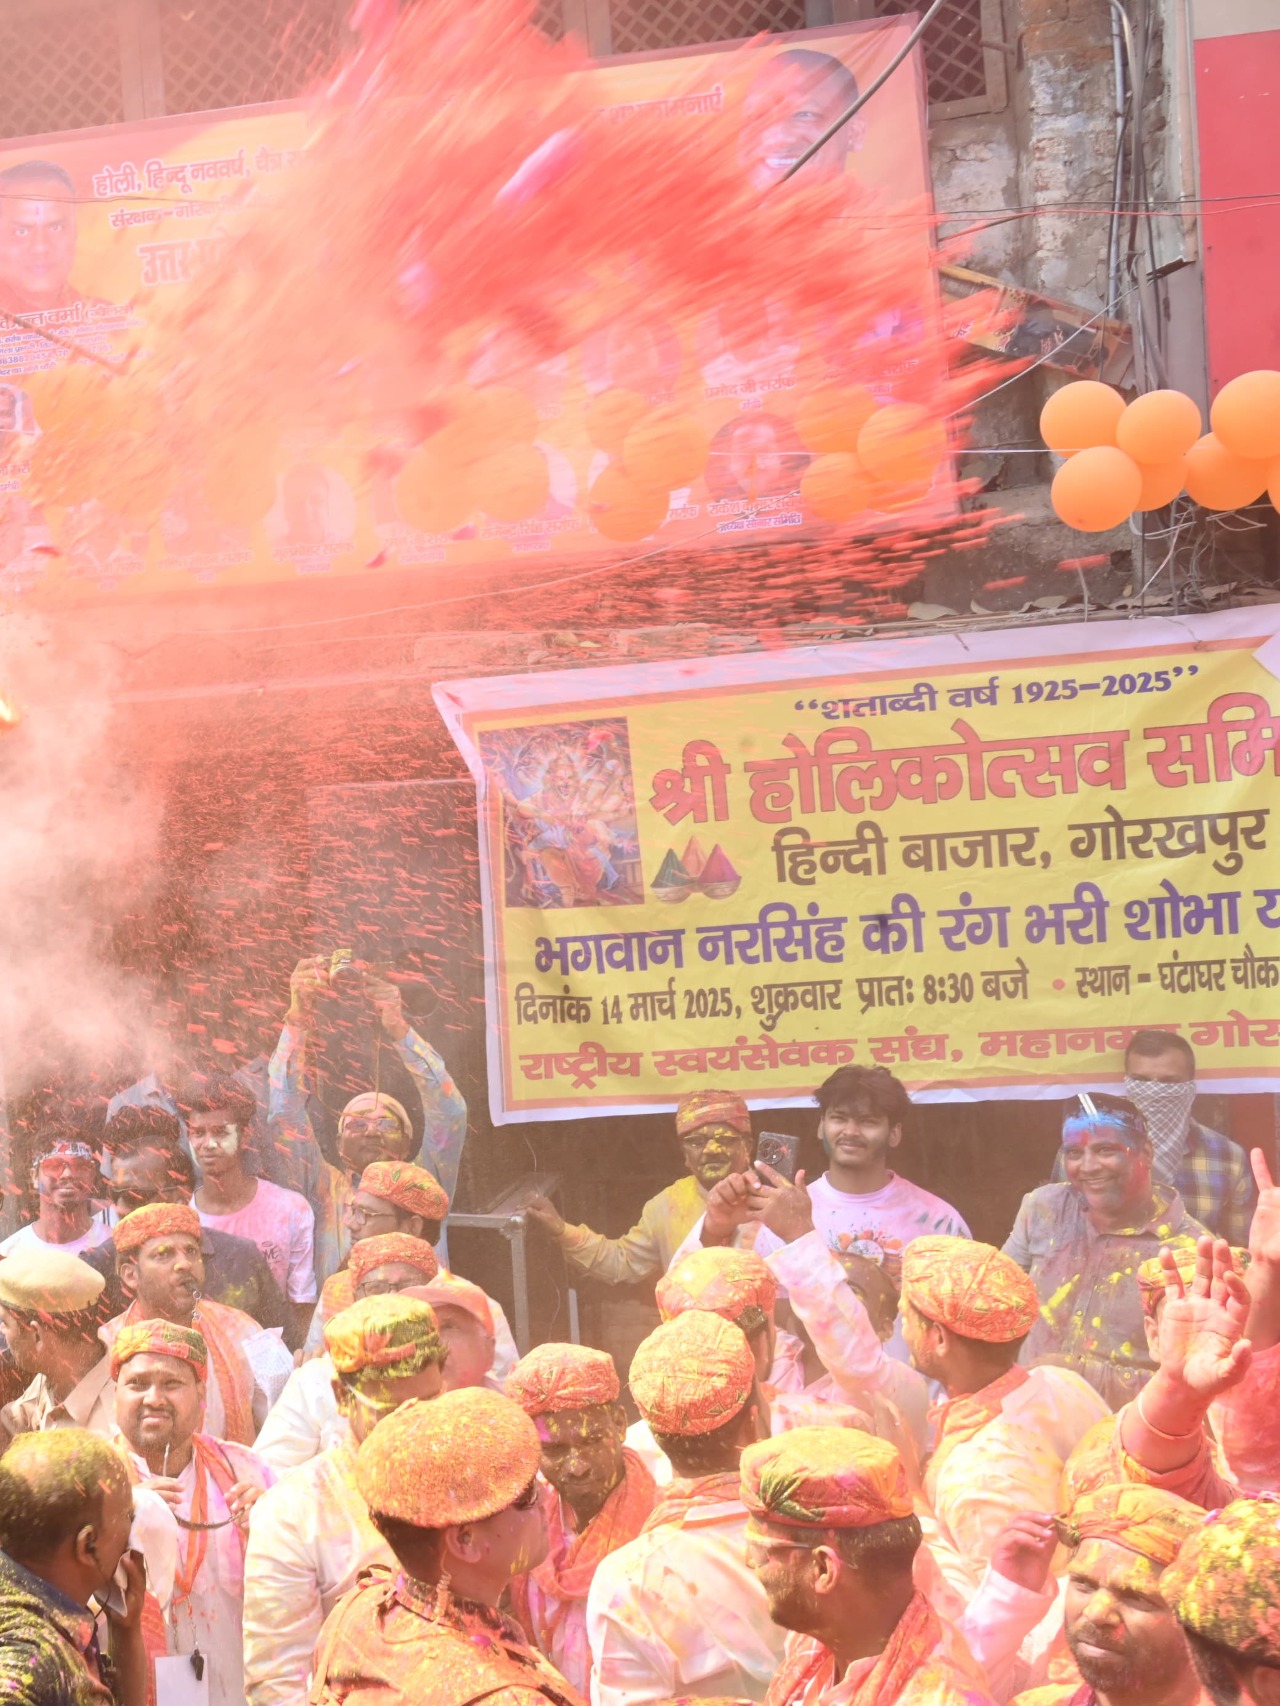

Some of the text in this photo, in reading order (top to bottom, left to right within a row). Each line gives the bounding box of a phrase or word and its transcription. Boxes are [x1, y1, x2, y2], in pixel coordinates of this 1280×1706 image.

[93, 160, 142, 197] होली,
[146, 160, 192, 193] हिन्दू
[47, 302, 81, 323] वर्मा
[946, 676, 999, 708] वर्ष
[649, 739, 731, 826] श्री
[743, 717, 1130, 824] होलिकोत्सव
[771, 804, 1270, 886] हिन्दी बाजार, गोरखपुर
[534, 928, 686, 975] भगवान
[695, 901, 848, 966] नरसिंह
[858, 892, 926, 954] की
[937, 890, 1011, 952] रंग
[1024, 880, 1110, 945] भरी
[1123, 878, 1242, 942] शोभा
[514, 981, 593, 1026] दिनांक
[600, 994, 624, 1026] 14
[627, 976, 677, 1021] मार्च
[683, 986, 742, 1020] 2025,
[750, 978, 843, 1032] शुक्रवार
[922, 971, 975, 1005] 8:30
[981, 956, 1030, 1000] बजे
[1074, 964, 1132, 999] स्थान
[1157, 948, 1227, 994] घंटाघर
[1229, 942, 1280, 990] चौक
[519, 1041, 644, 1091] राष्ट्रीय
[652, 1033, 858, 1077] स्वयंसेवक
